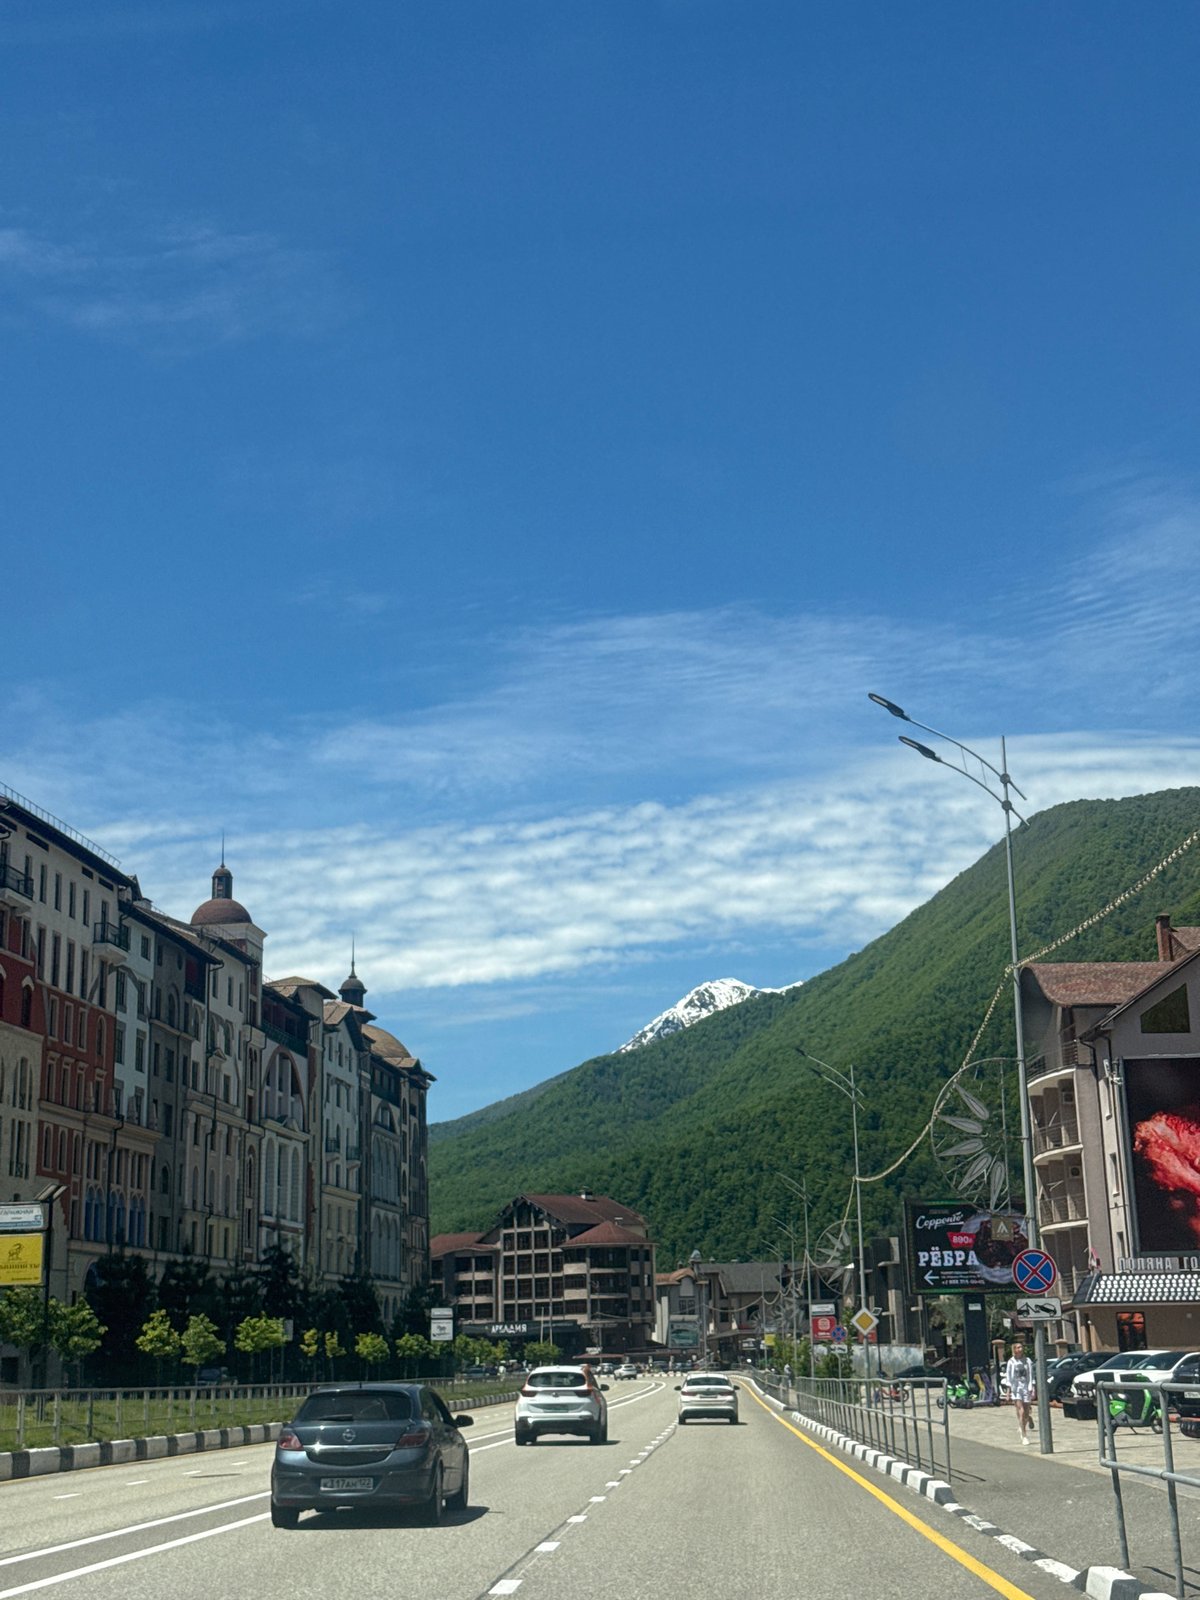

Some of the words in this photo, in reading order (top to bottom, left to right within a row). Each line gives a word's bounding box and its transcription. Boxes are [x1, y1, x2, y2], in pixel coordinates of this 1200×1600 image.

[916, 1211, 964, 1230] Сорренто
[918, 1246, 980, 1267] РЁБРА
[1119, 1256, 1172, 1271] ПОЛЯНА
[491, 1323, 527, 1334] АРКАДИЯ
